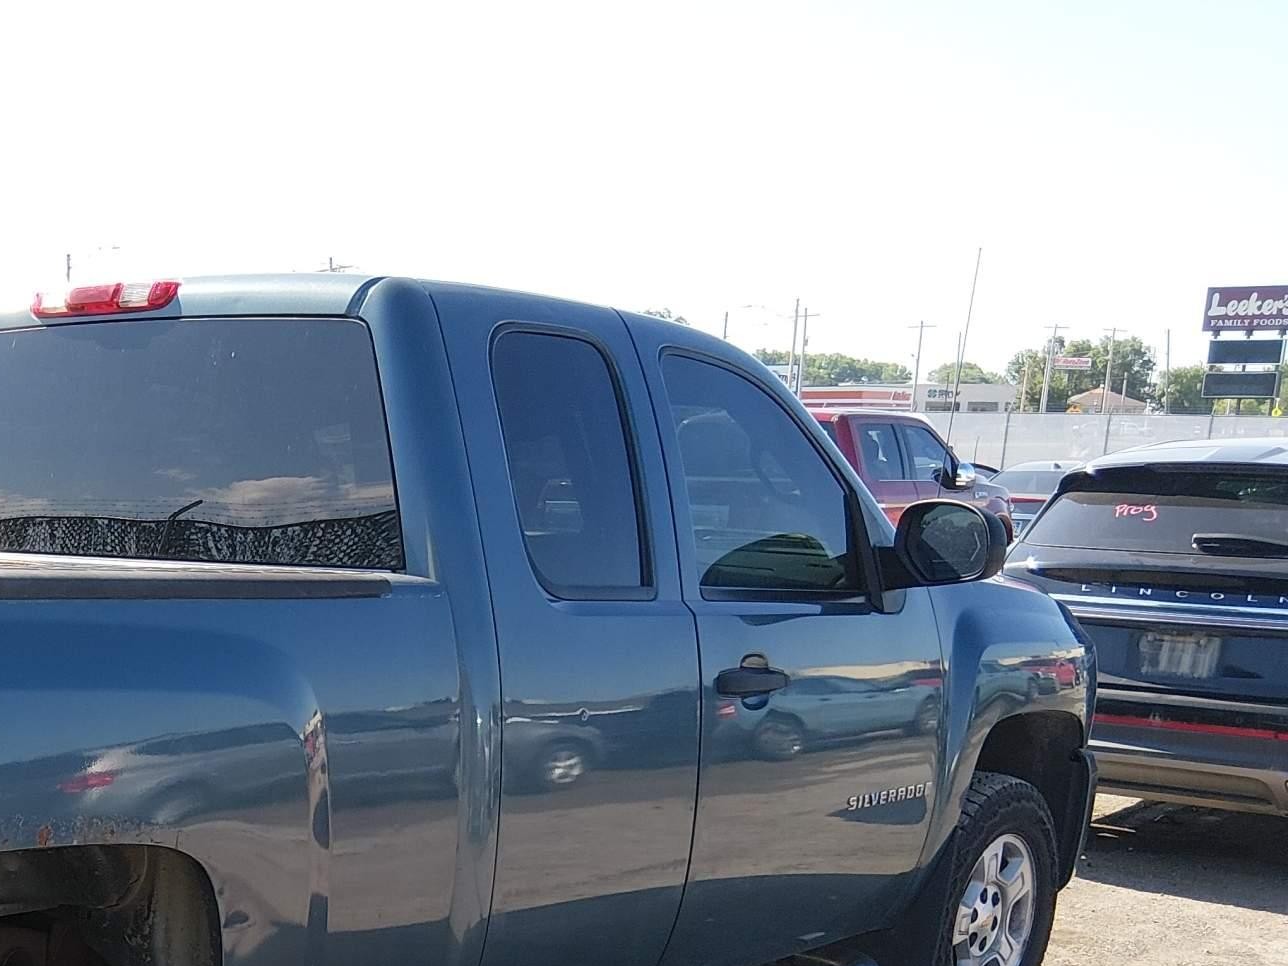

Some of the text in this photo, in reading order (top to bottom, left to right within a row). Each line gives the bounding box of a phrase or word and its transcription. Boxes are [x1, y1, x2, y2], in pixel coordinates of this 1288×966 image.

[1210, 319, 1250, 327] FAMILY
[1081, 584, 1288, 603] LINCOLN
[847, 783, 925, 811] SILVERADO
